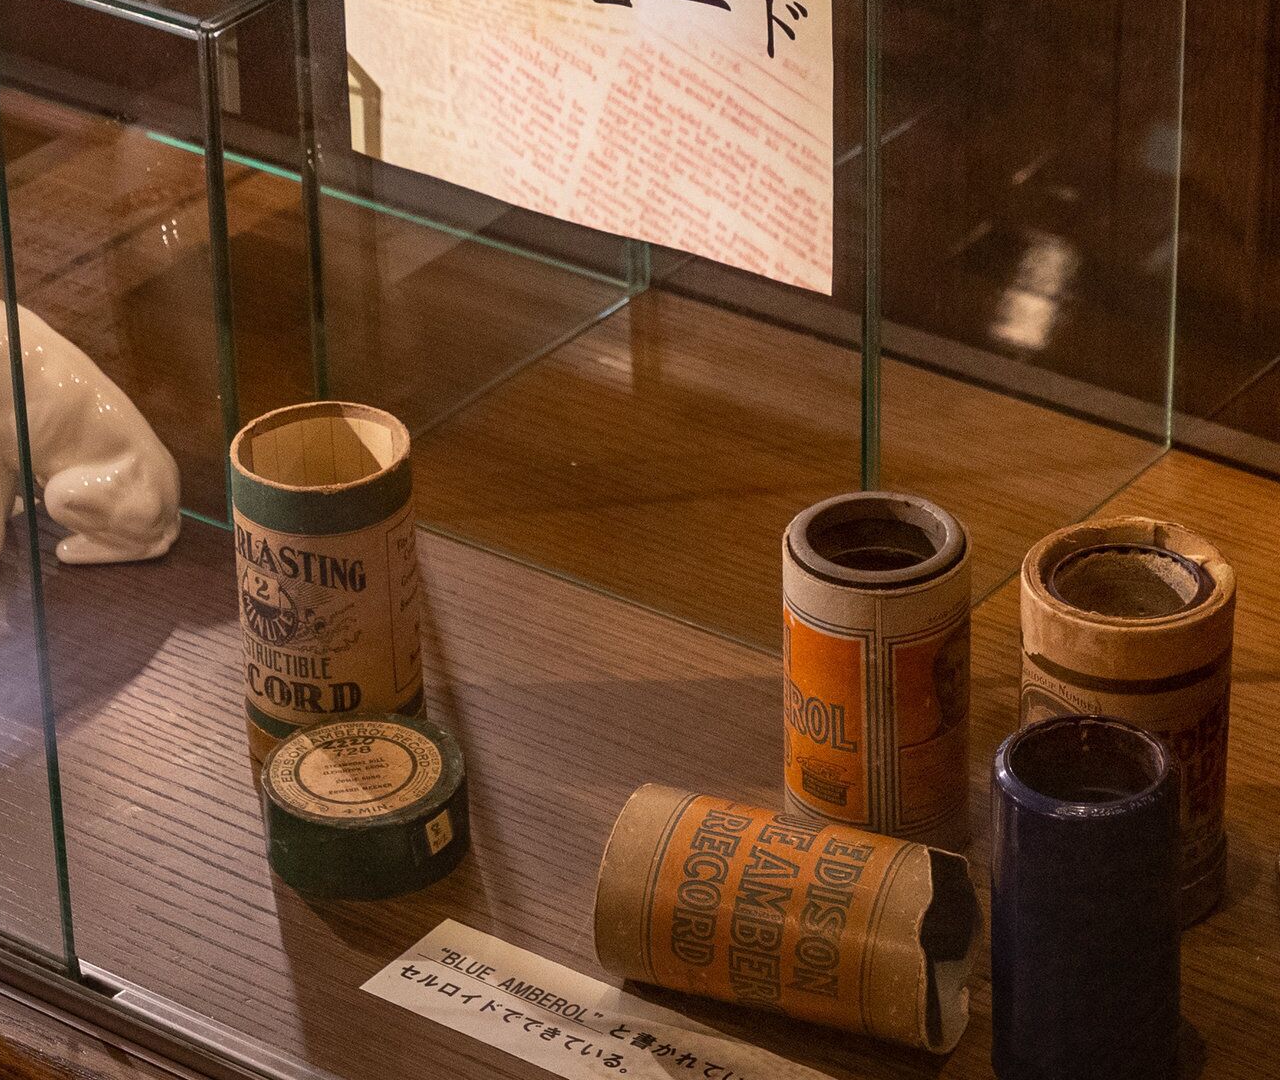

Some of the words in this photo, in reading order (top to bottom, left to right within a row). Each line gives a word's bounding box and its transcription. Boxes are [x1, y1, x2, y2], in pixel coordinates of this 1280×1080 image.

[254, 576, 271, 602] 2
[281, 744, 309, 784] EDISON
[309, 728, 387, 746] AMBEROL
[391, 732, 430, 769] RECORD
[332, 745, 373, 757] 728
[357, 802, 395, 815] MIN.
[671, 808, 753, 968] RECORD
[794, 837, 876, 998] EDISON
[400, 964, 627, 1074] セルロイドでできている。
